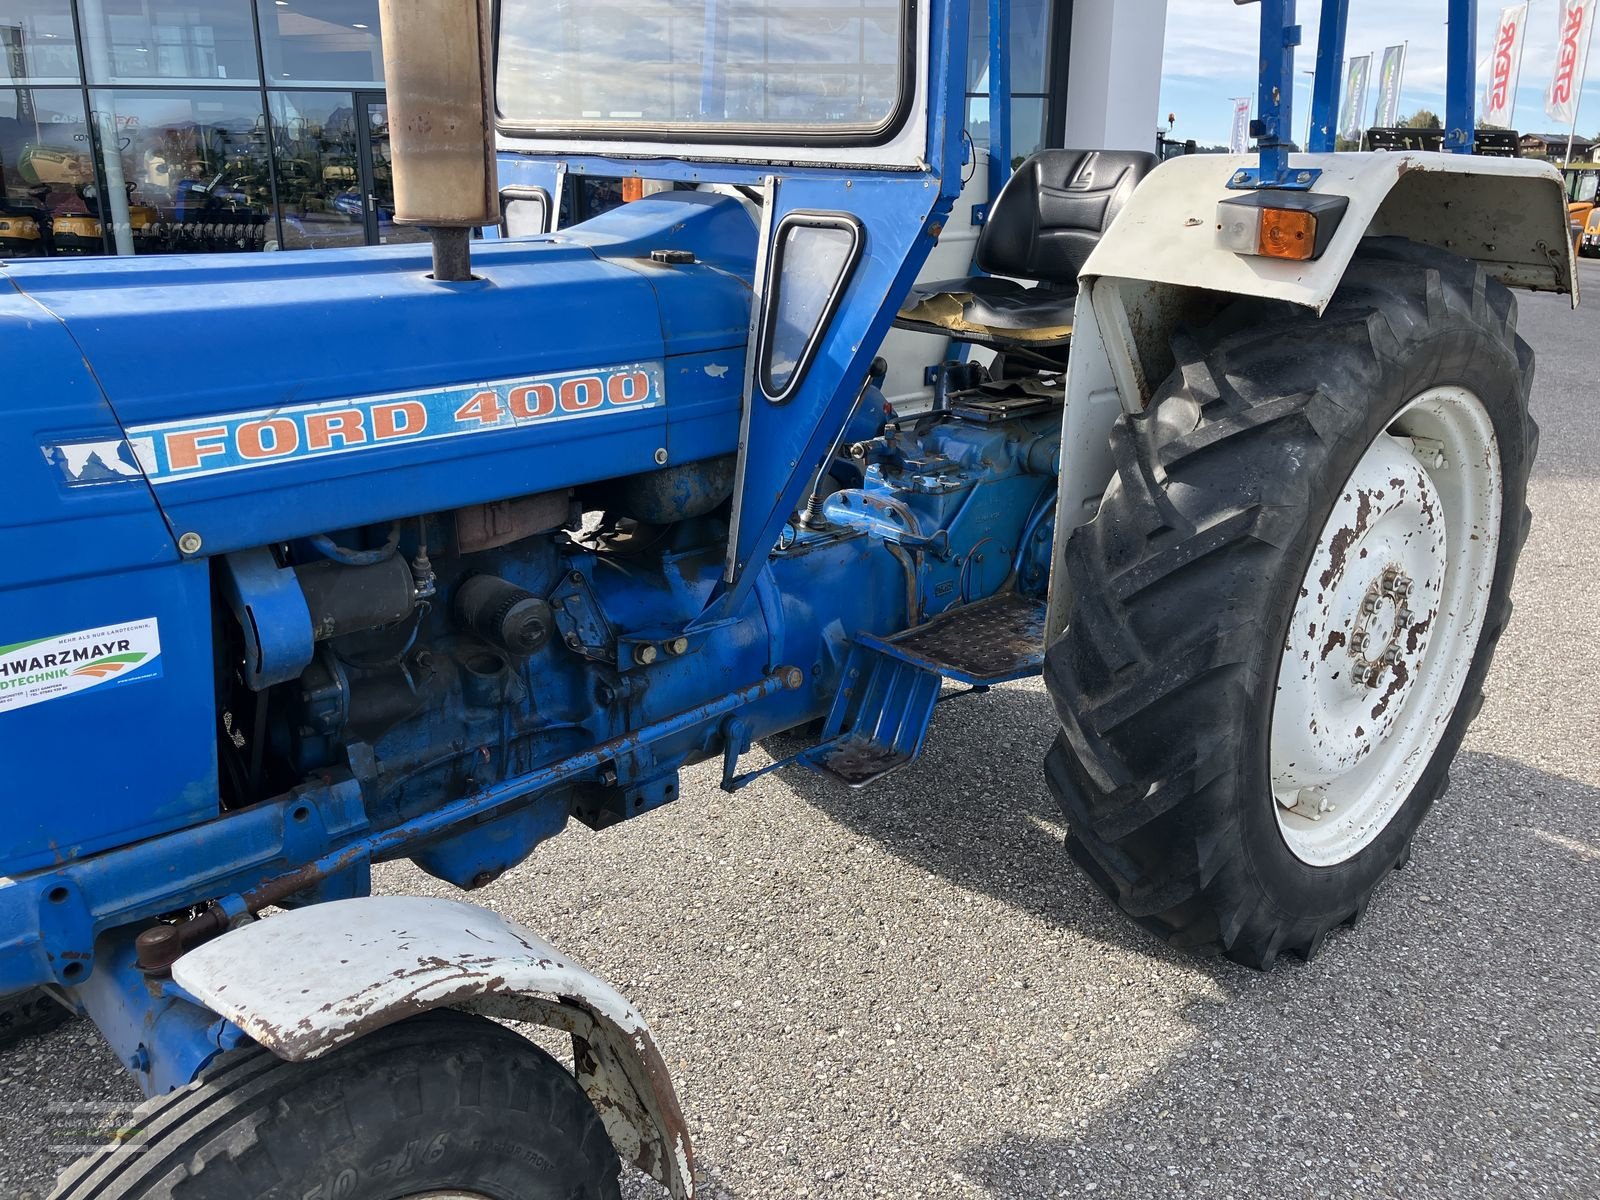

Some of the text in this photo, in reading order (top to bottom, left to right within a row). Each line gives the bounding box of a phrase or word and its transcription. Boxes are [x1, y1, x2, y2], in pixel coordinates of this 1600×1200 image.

[166, 369, 650, 473] FORD 4000
[78, 633, 91, 641] ALS
[92, 631, 106, 639] NUR
